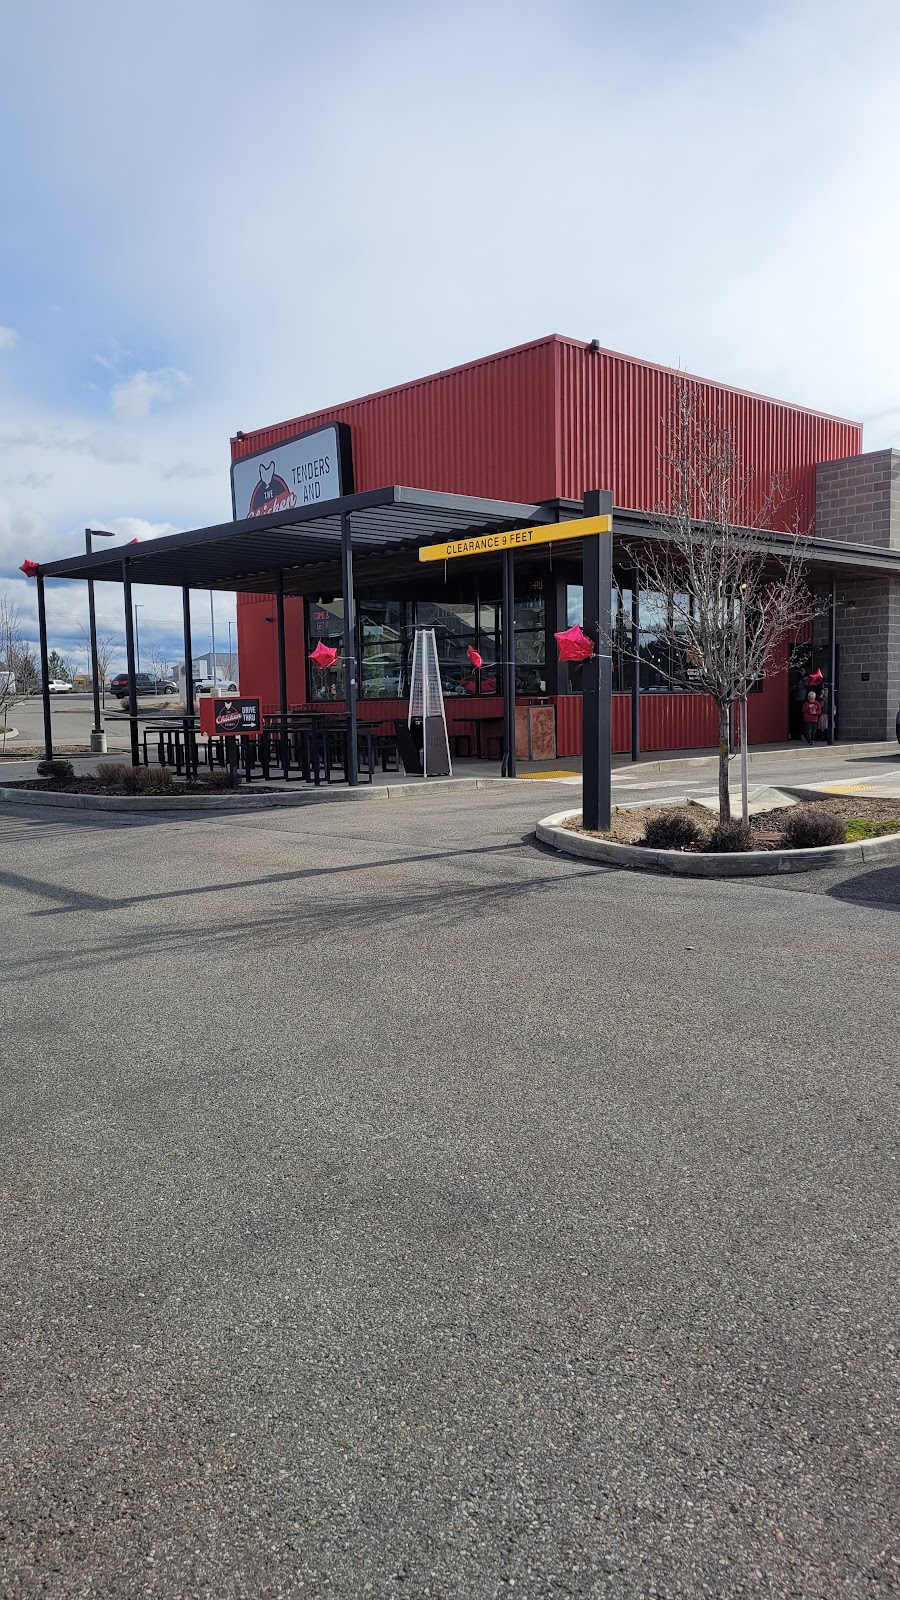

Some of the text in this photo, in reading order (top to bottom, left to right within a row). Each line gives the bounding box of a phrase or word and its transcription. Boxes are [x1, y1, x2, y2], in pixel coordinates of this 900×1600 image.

[291, 456, 330, 485] TENDERS
[263, 489, 274, 499] THE
[303, 481, 321, 503] AND
[446, 531, 534, 555] CLEARANCE 9 FEET
[241, 706, 256, 714] DRIVE
[216, 713, 242, 724] Chicken
[243, 714, 256, 722] THRU
